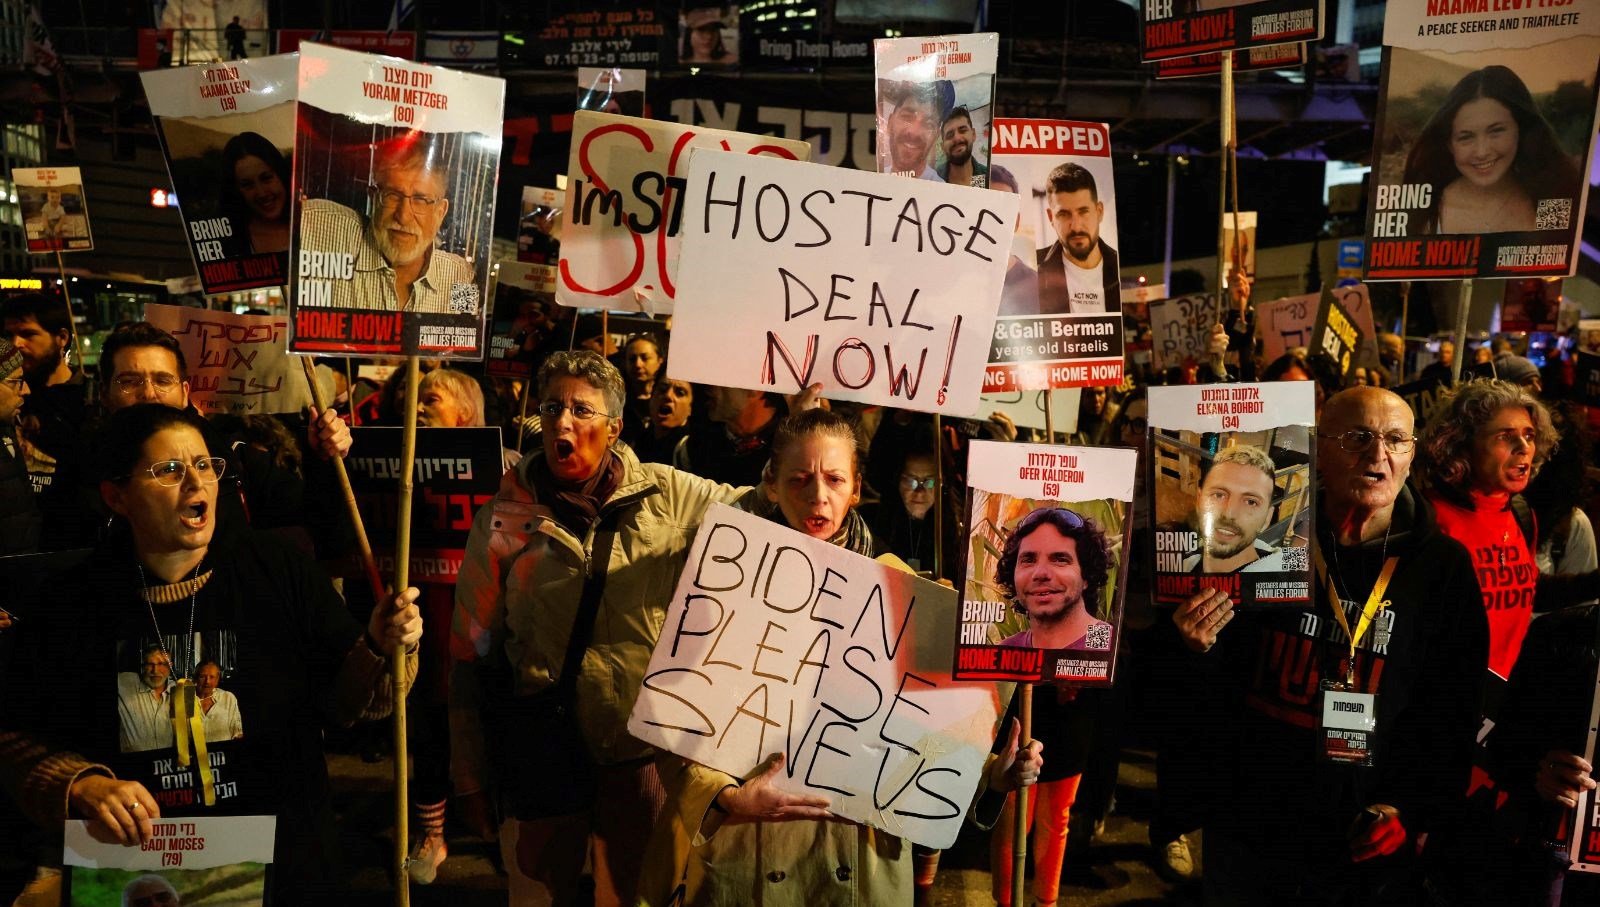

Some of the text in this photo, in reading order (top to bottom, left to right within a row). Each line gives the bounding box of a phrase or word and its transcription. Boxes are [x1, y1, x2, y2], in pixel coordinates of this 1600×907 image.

[1145, 0, 1173, 22] HER
[1145, 8, 1234, 48] HOME NOW!
[1252, 17, 1313, 37] FAMILIES FORUM
[1418, 13, 1580, 36] A PEACE SEEKER AND TRIATHLETE
[794, 39, 830, 58] Them
[831, 39, 868, 58] Home
[948, 53, 972, 64] BERMAN
[382, 66, 433, 89] יורם מצגר
[199, 80, 251, 99] NAAMA LEVY
[363, 81, 448, 111] YORAM METZGER
[220, 96, 237, 112] (19)
[393, 104, 415, 125] (80)
[1375, 183, 1433, 210] BRING
[703, 171, 1003, 263] HOSTAGE
[1372, 211, 1409, 238] HER
[190, 216, 233, 241] BRING
[195, 240, 226, 262] HER
[1370, 235, 1481, 267] HOME NOW!
[1498, 244, 1568, 255] HOSTAGES AND MISSING
[202, 253, 280, 285] HOME NOW!
[299, 251, 354, 280] BRING
[1496, 254, 1567, 267] FAMILIES FORUM
[298, 280, 331, 308] HIM
[777, 266, 934, 331] DEAL
[171, 319, 287, 345] הפסקת
[296, 309, 404, 342] HOME NOW!
[419, 325, 477, 336] HOSTAGES AND MISSING
[995, 320, 1115, 341] &Gali Berman
[419, 334, 477, 348] FAMILIES FORUM
[491, 336, 515, 349] BRING
[995, 340, 1109, 360] years old Israelis
[199, 347, 258, 370] אש
[490, 347, 505, 359] HIM
[761, 314, 962, 406] NOW!
[1052, 366, 1088, 383] HOME
[1091, 365, 1121, 380] NOW!
[1201, 388, 1260, 402] אלקנה בוחבוט
[1197, 401, 1265, 415] ELKANA BOHBOT
[1222, 415, 1240, 429] (34)
[345, 457, 473, 484] פדיון שבויי
[1028, 452, 1078, 469] עופר קלדרון
[1019, 467, 1084, 483] OFER KALDERON
[1042, 482, 1060, 498] (53)
[1155, 531, 1199, 552] BRING
[1156, 552, 1182, 573] HIM
[694, 522, 915, 661] BIDEN
[1156, 573, 1241, 597] HOME NOW!
[1255, 581, 1280, 590] HOSTAGES
[1288, 581, 1309, 589] MISSING
[1255, 588, 1309, 599] FAMILIES FORUM
[962, 600, 1006, 623] BRING
[960, 623, 988, 646] HIM
[958, 648, 1043, 673] HOME NOW!
[1057, 658, 1109, 669] HOSTAGES AND MISSING
[671, 593, 937, 758] PLEASE
[1055, 665, 1108, 678] FAMILIES FORUM
[1332, 701, 1365, 714] משפחות
[642, 667, 961, 819] SAVE US
[152, 824, 196, 837] גדי מוזס
[141, 838, 205, 851] GADI MOSES
[162, 851, 182, 867] (79)
